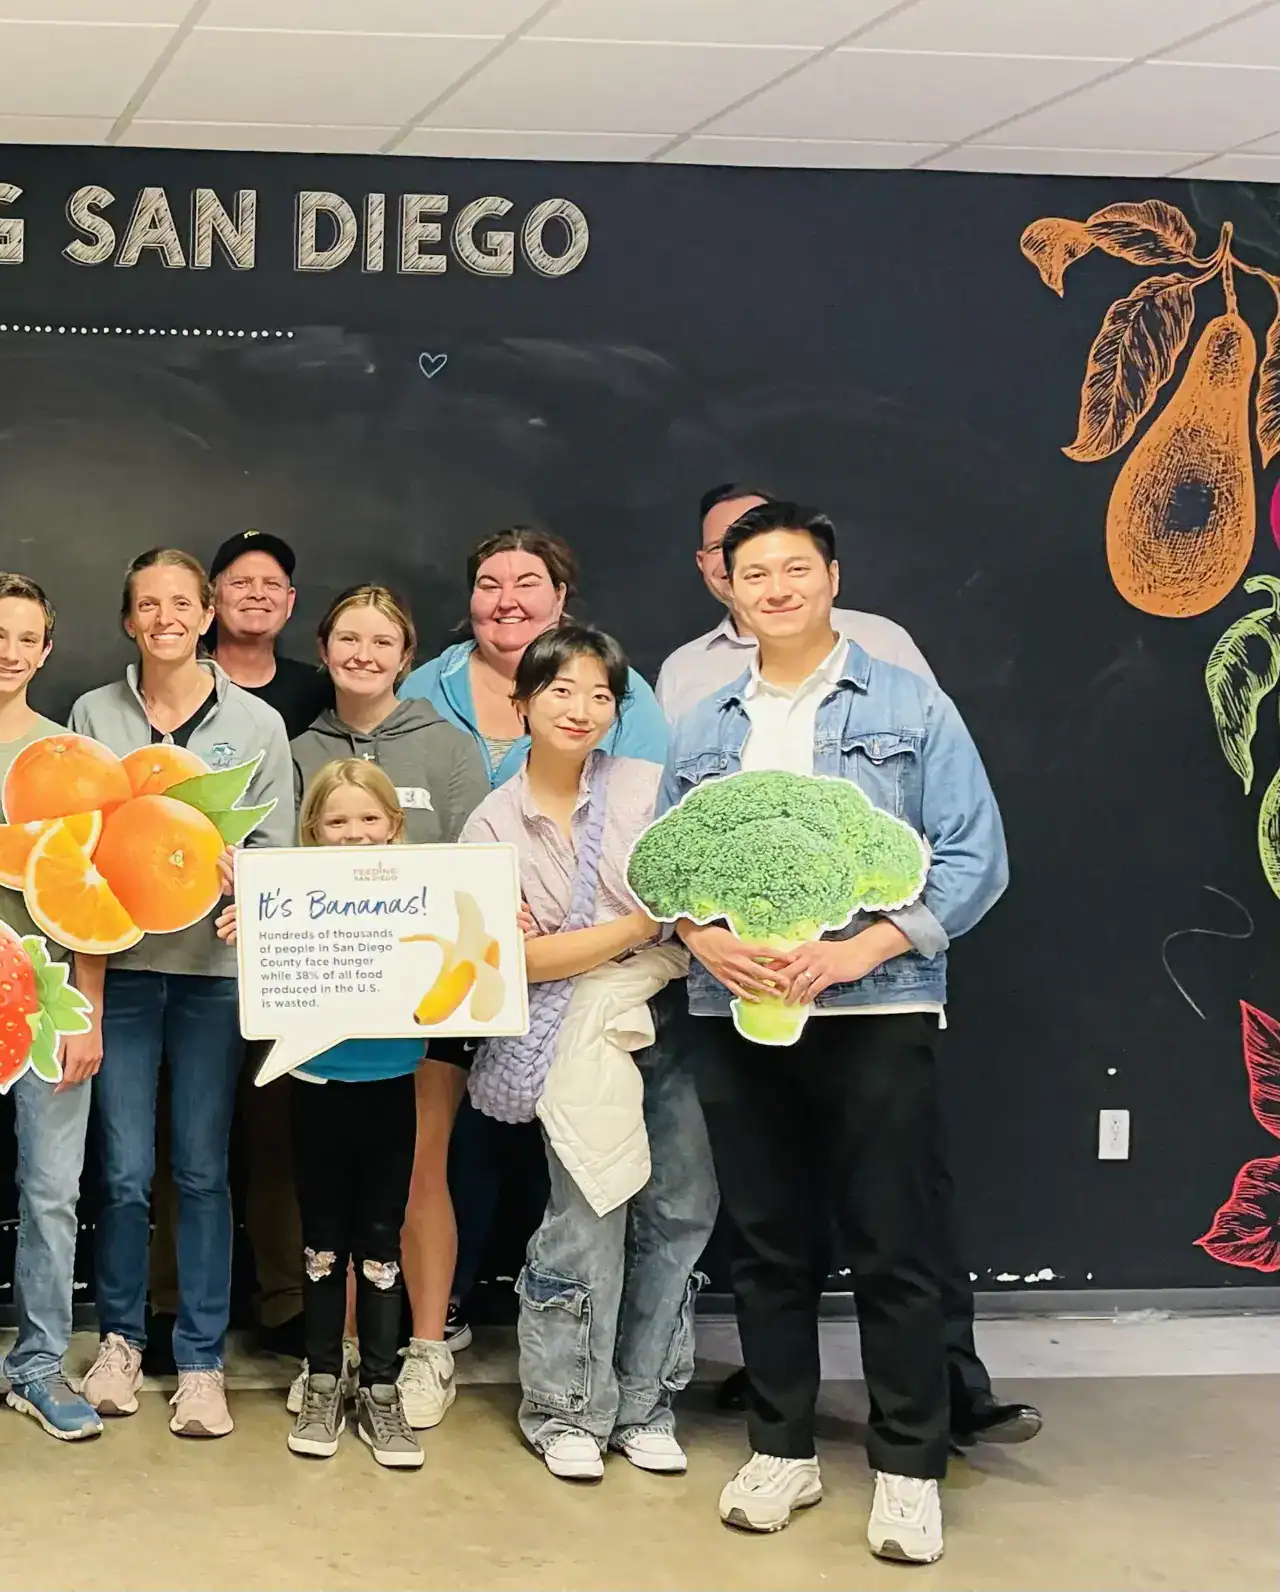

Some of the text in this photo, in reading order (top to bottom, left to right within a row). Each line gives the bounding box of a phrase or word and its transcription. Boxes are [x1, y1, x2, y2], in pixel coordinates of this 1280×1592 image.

[61, 184, 257, 270] SAN
[293, 190, 590, 277] DIEGO
[258, 886, 428, 921] It's Bananas!
[259, 929, 394, 941] Hundreds of thousands
[259, 942, 393, 955] of people in San Diego
[260, 956, 374, 969] County face hunger
[261, 969, 383, 981] while 38% of all food
[261, 983, 381, 996] produced in the U.S.
[261, 997, 320, 1008] is wasted.
